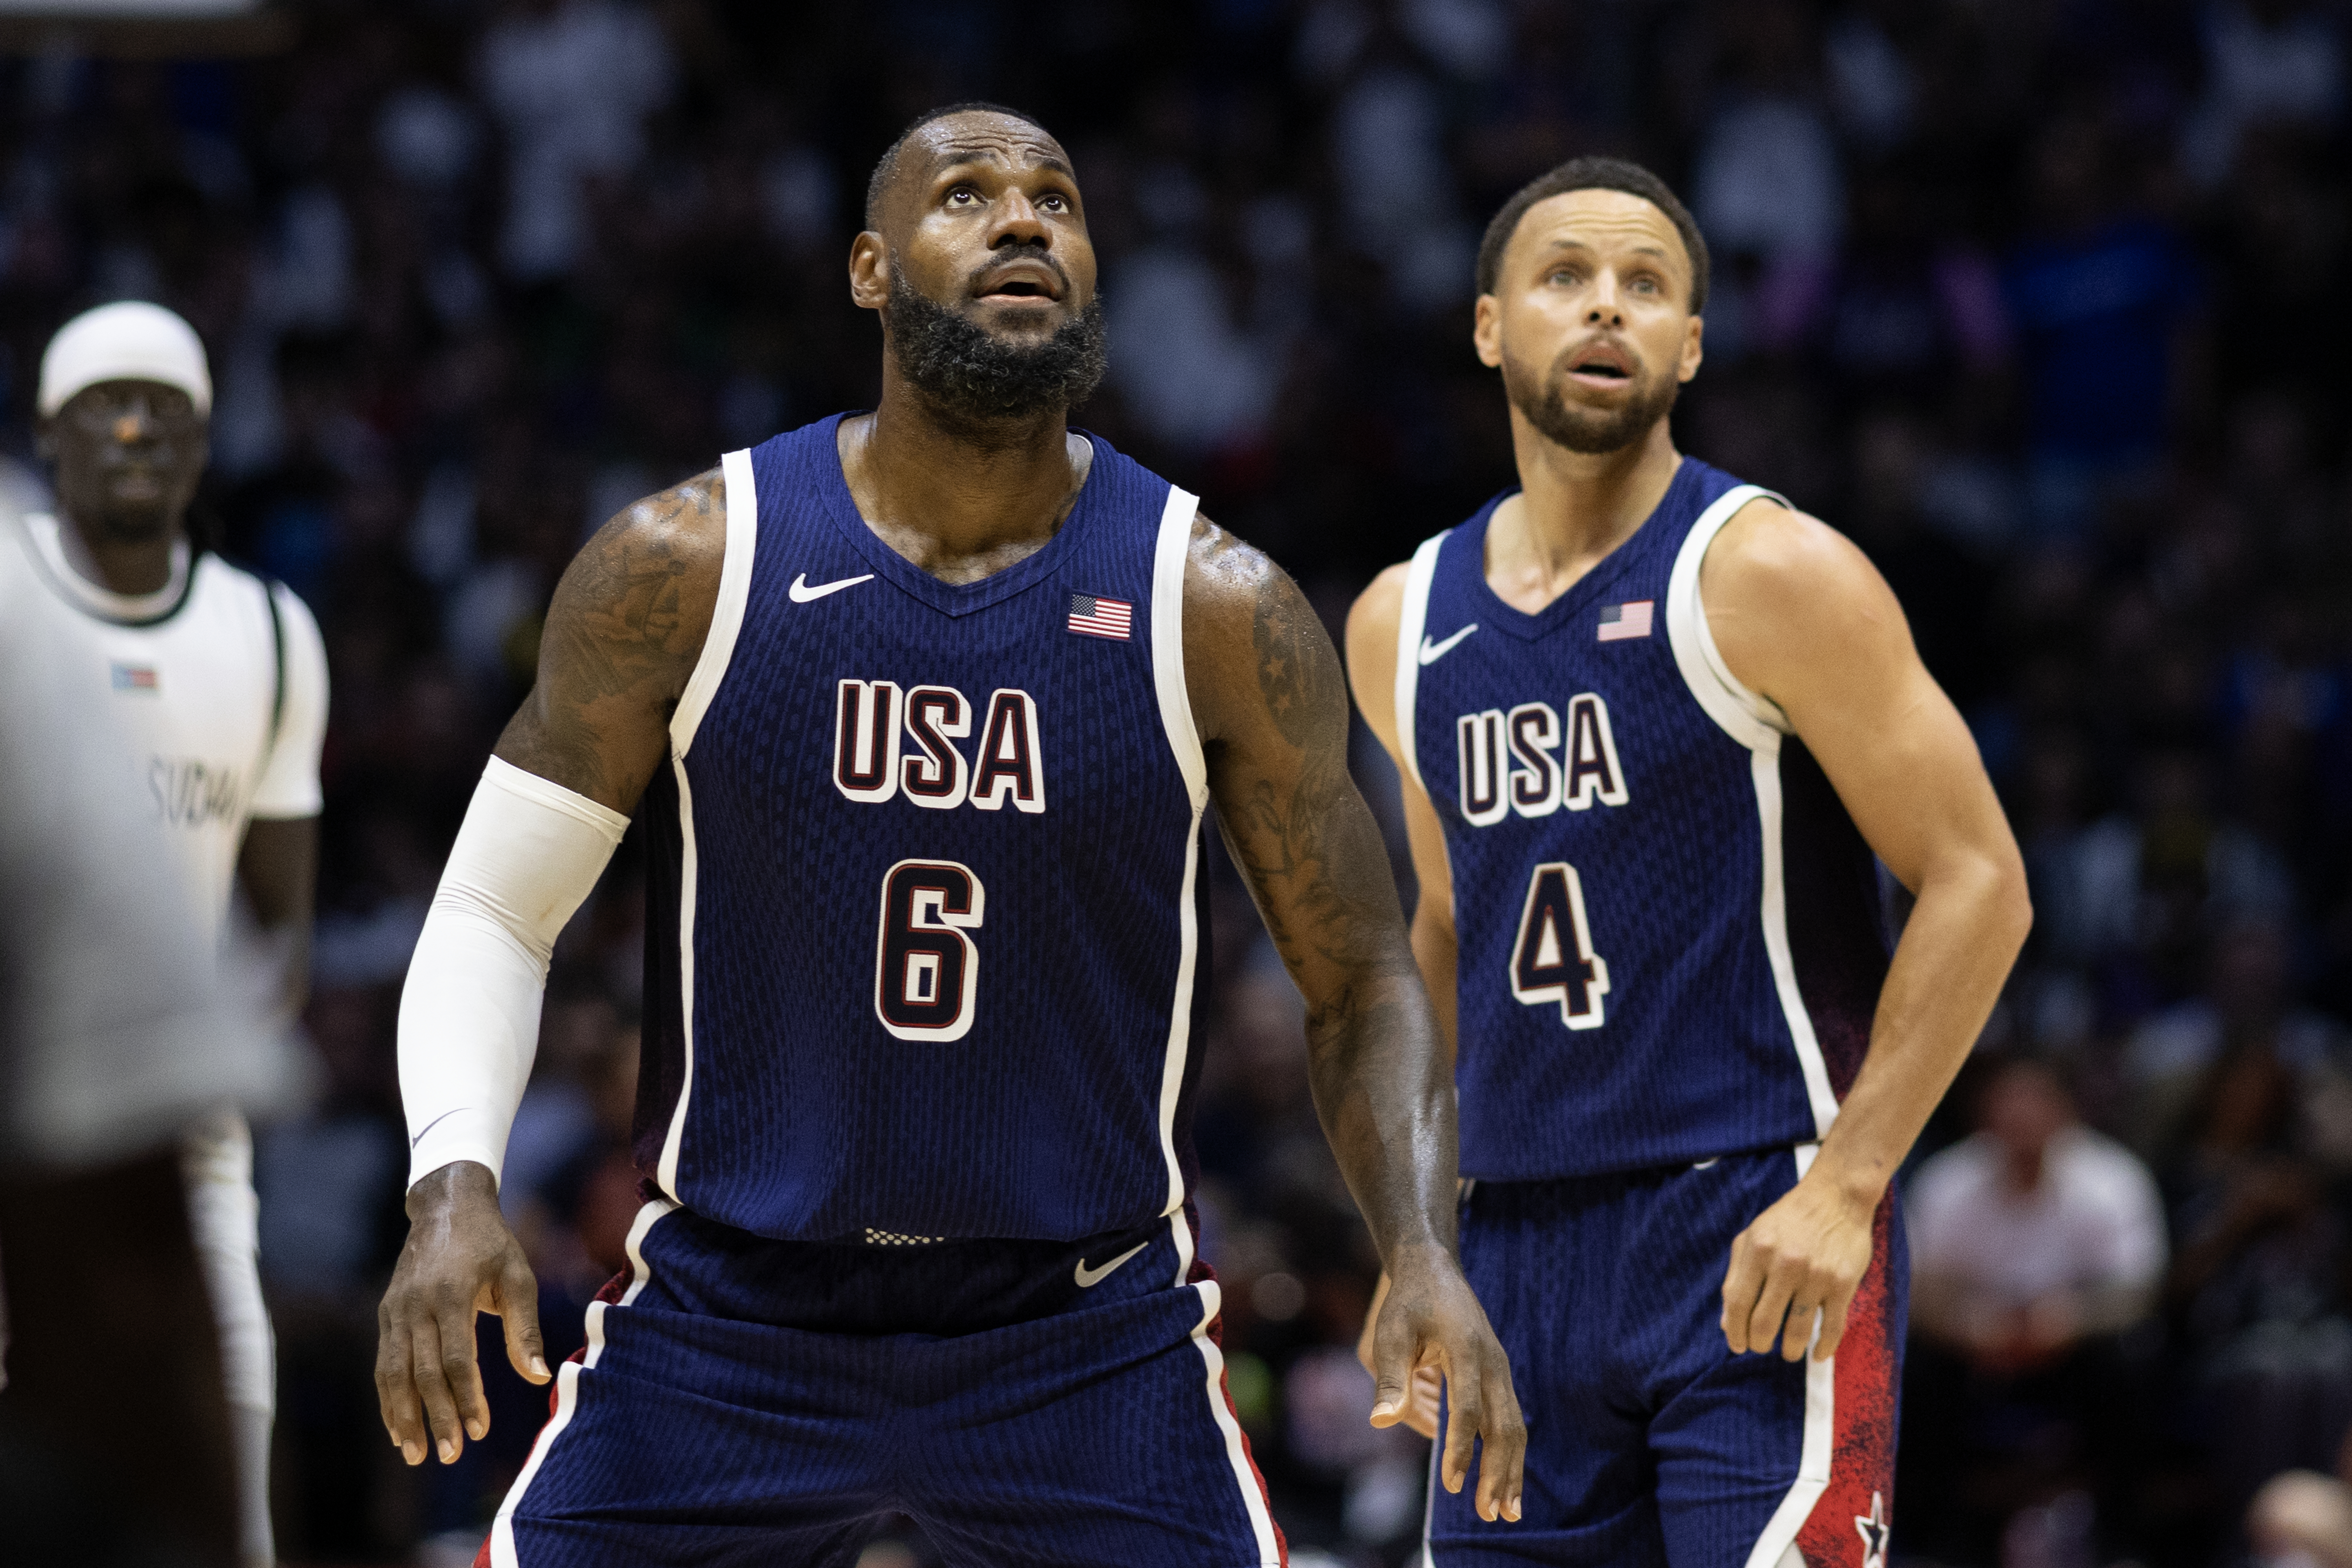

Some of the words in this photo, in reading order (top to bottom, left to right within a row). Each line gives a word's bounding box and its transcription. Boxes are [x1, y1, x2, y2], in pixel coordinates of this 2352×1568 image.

[833, 679, 1045, 813] USA
[1457, 692, 1629, 826] USA
[875, 858, 985, 1042] 6
[1509, 862, 1610, 1030] 4
